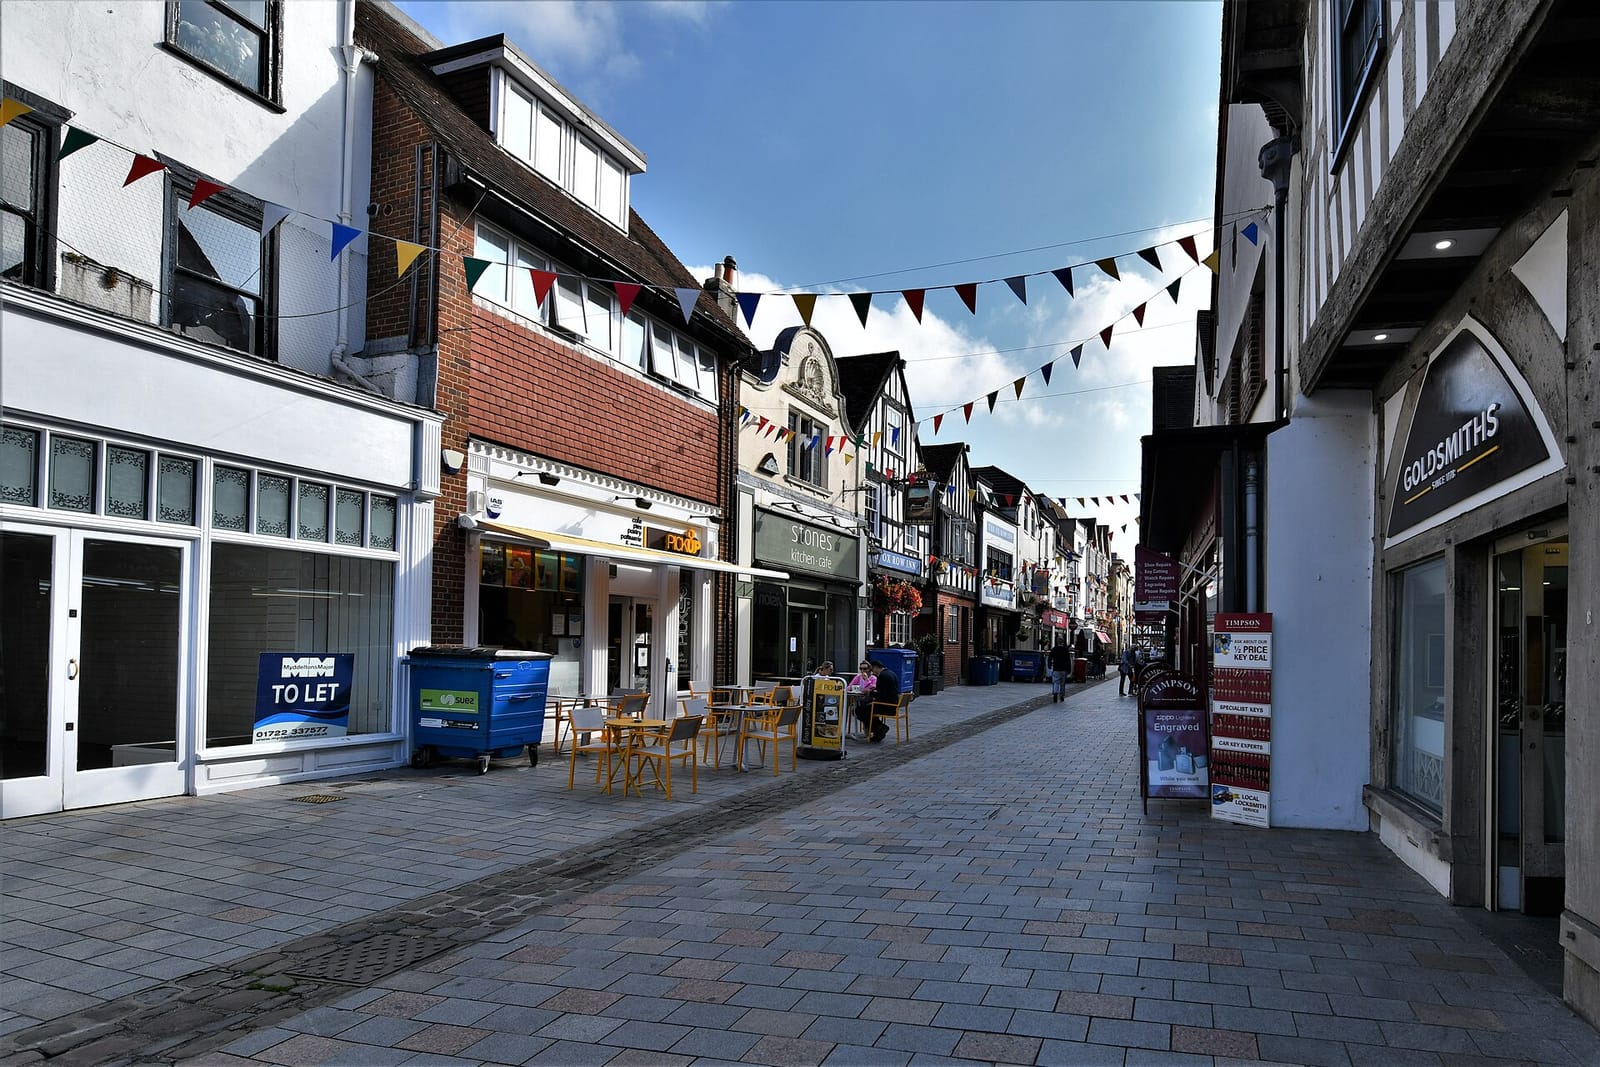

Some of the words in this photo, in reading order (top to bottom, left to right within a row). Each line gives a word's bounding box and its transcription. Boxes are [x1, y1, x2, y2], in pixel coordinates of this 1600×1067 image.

[1403, 403, 1499, 492] GOLDSMITHS
[1431, 475, 1446, 490] SINCE
[666, 533, 701, 555] PICKUP
[791, 524, 833, 551] stones
[791, 548, 815, 566] kitchen
[819, 556, 832, 569] cafe
[882, 552, 891, 563] OX
[892, 555, 905, 566] ROW
[906, 559, 917, 570] INN
[1243, 645, 1268, 654] PRICE
[271, 684, 299, 704] TO
[304, 683, 339, 702] LET
[1151, 679, 1198, 695] TIMPSON
[256, 729, 288, 738] 01722
[291, 726, 329, 735] 337577
[1153, 722, 1200, 732] Engraved
[1235, 799, 1267, 809] LOCKSMITH
